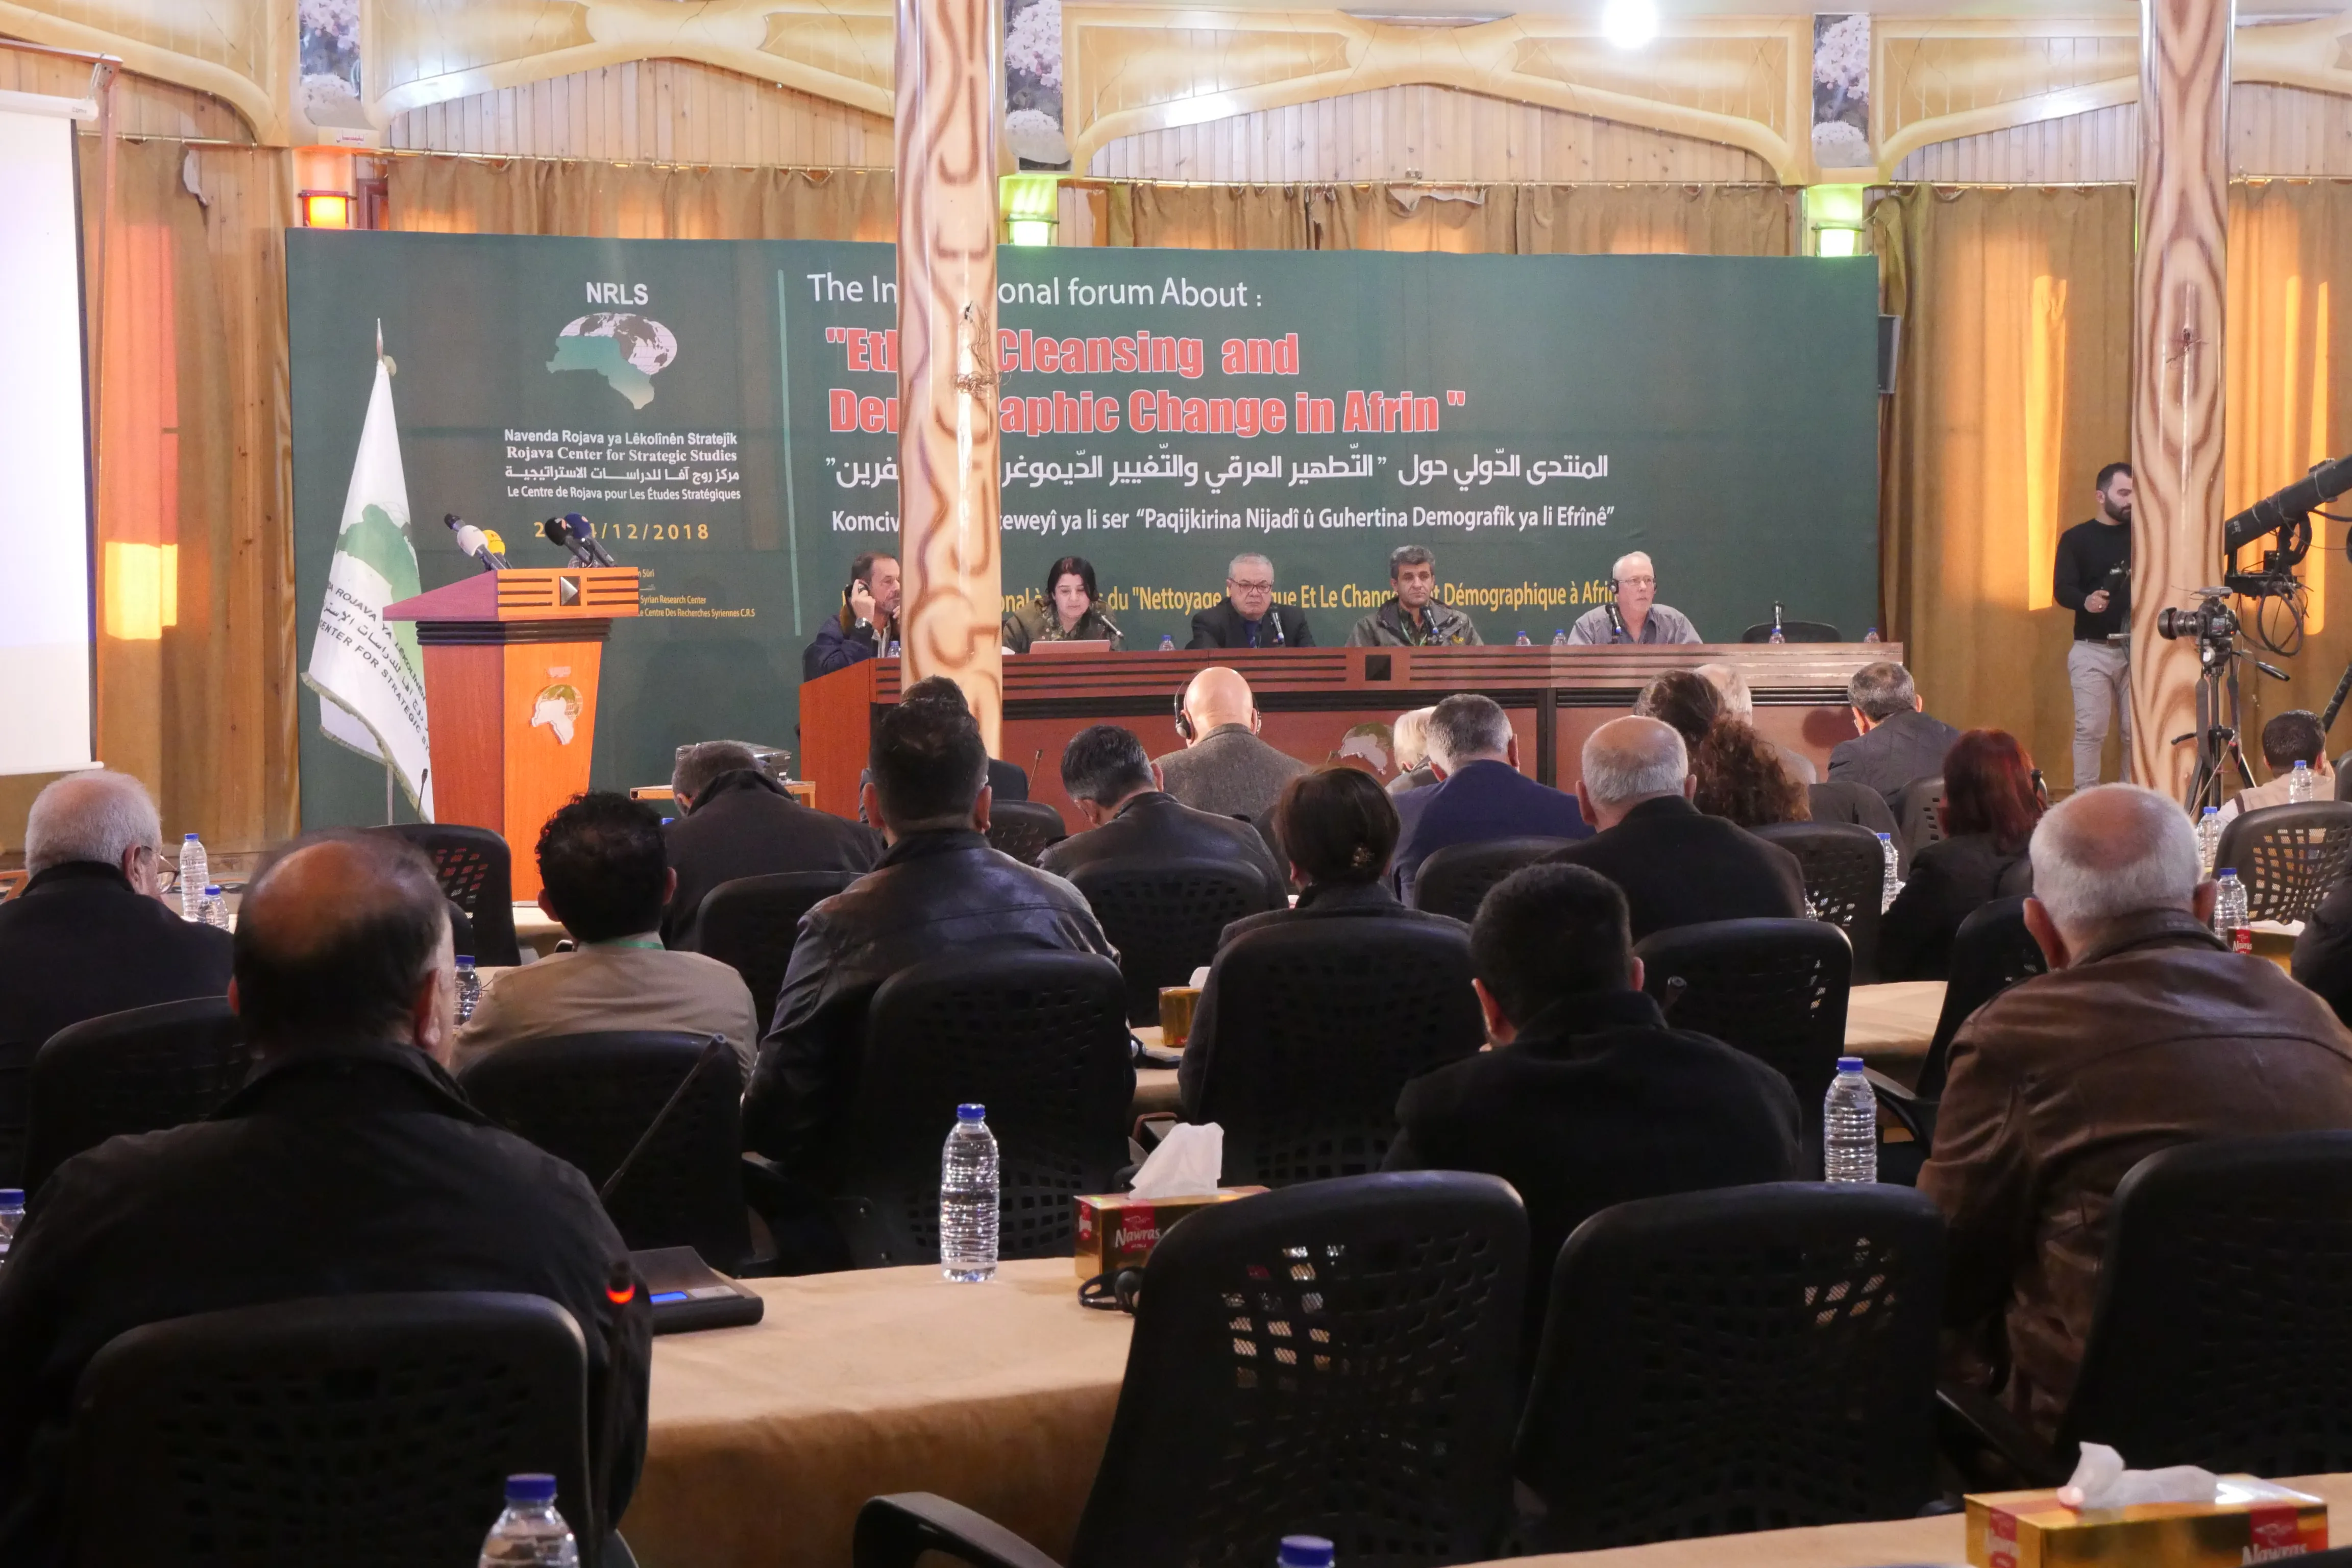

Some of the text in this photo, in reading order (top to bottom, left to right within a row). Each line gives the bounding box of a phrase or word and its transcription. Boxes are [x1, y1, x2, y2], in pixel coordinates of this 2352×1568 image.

[587, 282, 648, 305] NRLS
[807, 272, 863, 302] The
[1068, 278, 1154, 305] forum
[998, 328, 1204, 379] Cleansing
[1221, 333, 1299, 375] and
[1129, 389, 1286, 437] Change
[1295, 392, 1335, 433] in
[505, 429, 737, 448] Navenda Rojava ya Lêkolînên Stratejîk
[507, 447, 737, 464] Rojava Center for Strategic Studies
[1399, 454, 1447, 485] حول
[1527, 455, 1607, 485] المنتدى
[693, 472, 712, 484] روج
[715, 469, 739, 483] مركز
[1205, 455, 1282, 494] العرقي
[508, 486, 741, 502] Le Centre de Rojava pour Les Études Stratégiques
[1061, 515, 1082, 535] ya
[1087, 509, 1096, 529] li
[1102, 513, 1129, 528] ser
[1246, 508, 1299, 533] Nijadî
[1304, 508, 1313, 528] û
[1319, 507, 1407, 528] Guhertina
[1413, 505, 1515, 531] Demografîk
[1519, 511, 1538, 531] ya
[1544, 506, 1552, 525] li
[640, 595, 706, 605] Syrian Research Center
[1108, 586, 1128, 610] du
[1301, 585, 1316, 608] Et
[1320, 585, 1337, 607] Le
[1444, 581, 1566, 611] Démographique
[1570, 581, 1578, 604] à
[335, 587, 378, 623] ROJAVA
[382, 624, 393, 640] YA
[666, 608, 676, 617] Des
[678, 608, 710, 617] Recherches
[711, 609, 739, 619] Syriennes
[355, 645, 380, 668] FOR
[381, 669, 421, 733] STRATEGIC
[1115, 1228, 1161, 1248] Nawras
